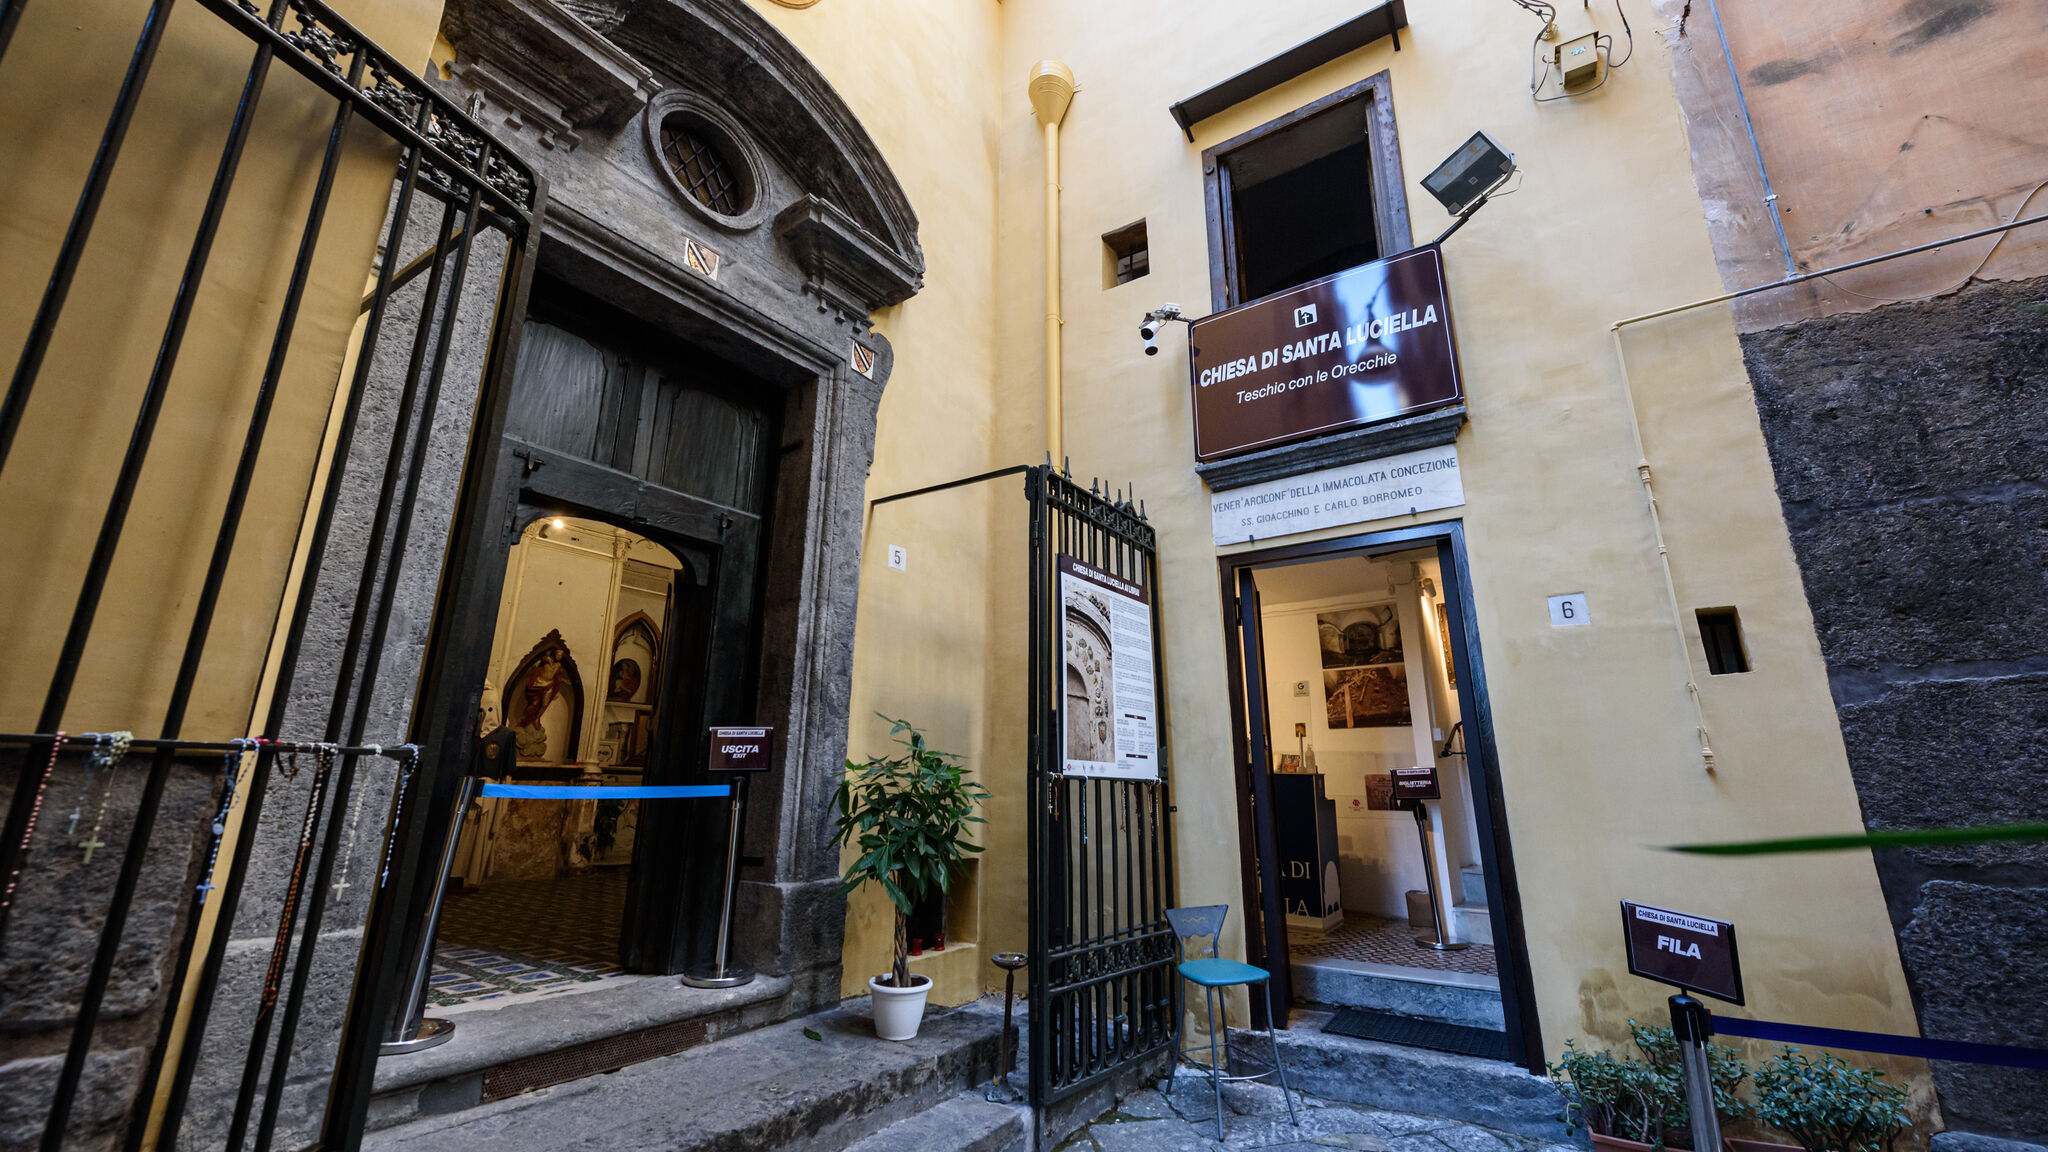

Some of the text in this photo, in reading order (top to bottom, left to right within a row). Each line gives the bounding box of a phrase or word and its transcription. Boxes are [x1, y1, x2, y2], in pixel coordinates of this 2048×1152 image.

[1200, 304, 1438, 387] CHIESA DI SANTA LUCIELLA
[1236, 353, 1397, 404] Teschio con le Orecchie
[1290, 484, 1320, 499] DELLA
[1323, 471, 1387, 492] IMMACOLATA
[1390, 457, 1457, 479] CONCEZIONE
[1241, 486, 1423, 527] SS. GIOACCHINO E CARLO BORROMEO
[894, 550, 901, 565] 5
[1073, 562, 1089, 576] CHIESA
[1561, 601, 1574, 619] 6
[721, 745, 759, 754] USCITA
[1290, 860, 1311, 879] DI
[1638, 909, 1715, 933] CHIESA DI SANTA LUCIELLA
[1657, 934, 1701, 960] FILA
